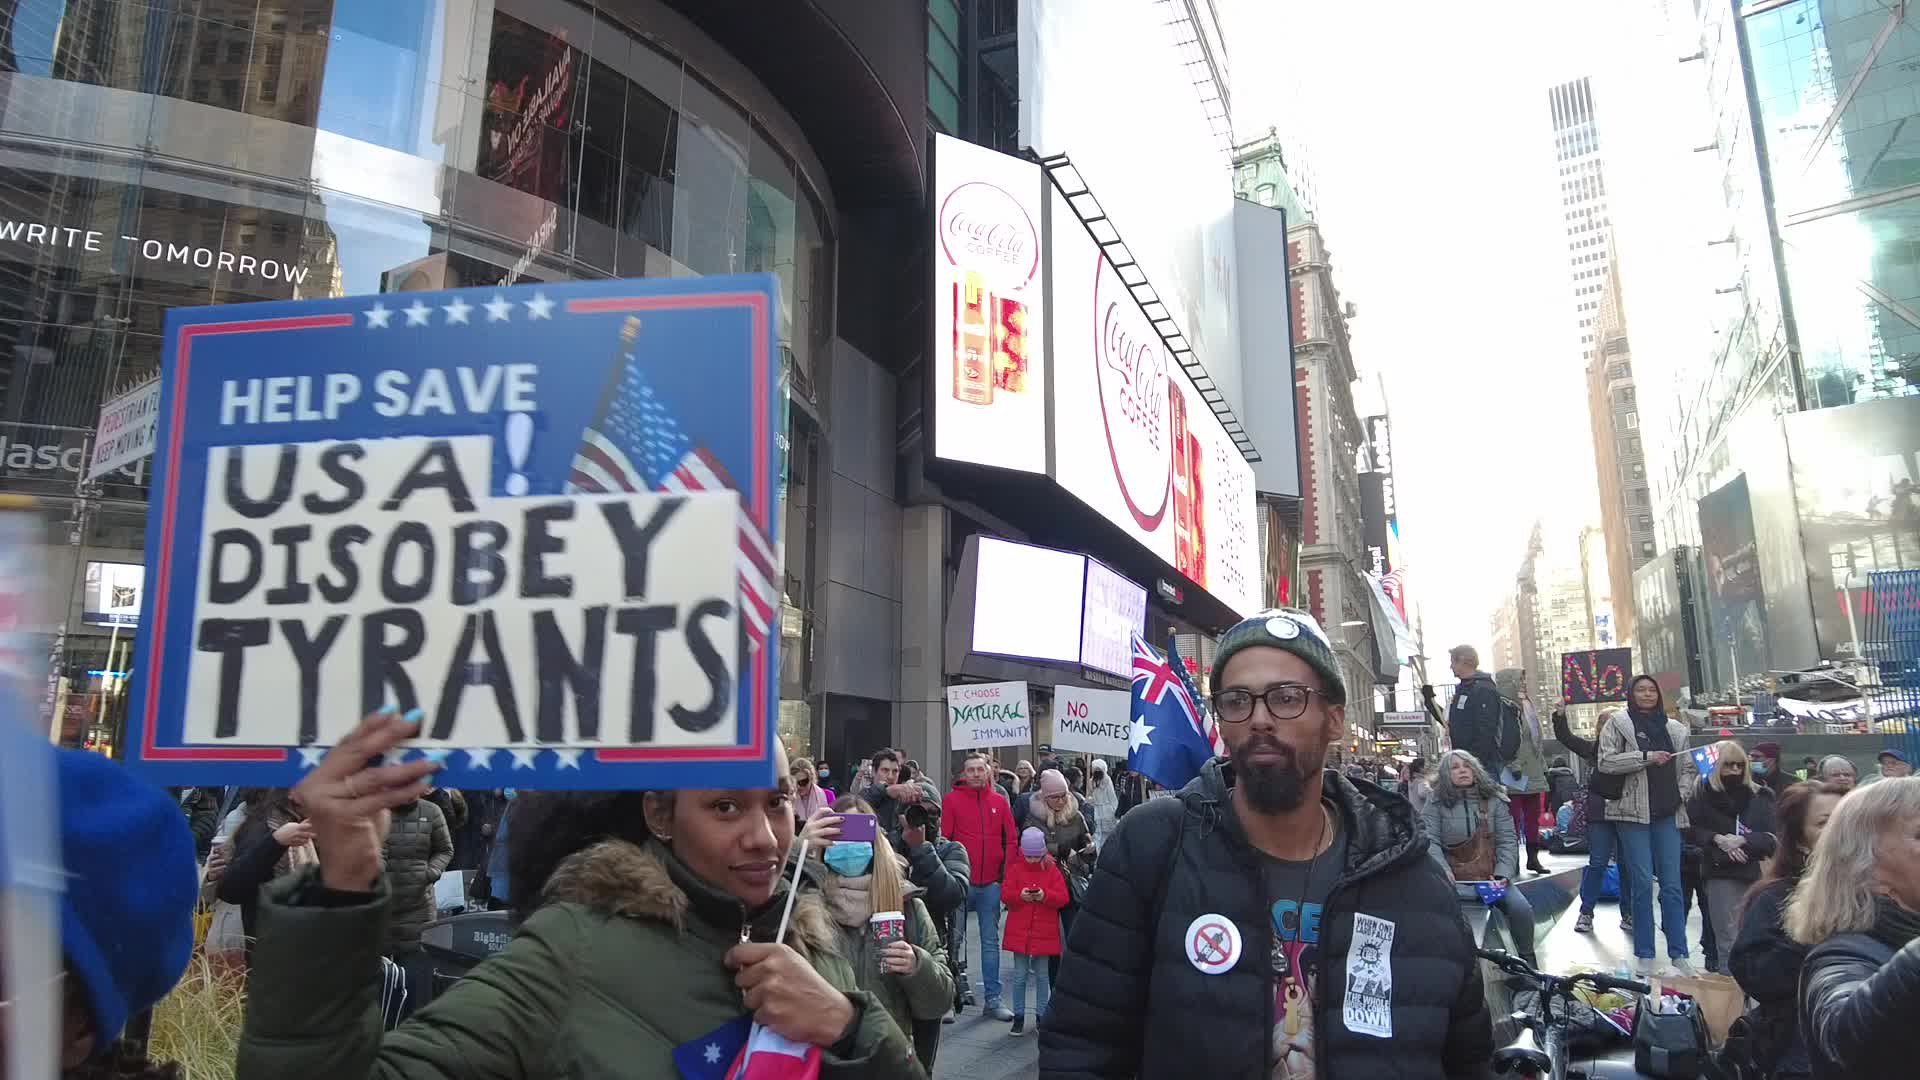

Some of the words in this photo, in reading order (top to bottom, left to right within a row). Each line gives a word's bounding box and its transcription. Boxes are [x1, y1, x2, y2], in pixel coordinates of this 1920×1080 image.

[220, 374, 361, 425] HELP
[374, 364, 538, 416] SAVE
[207, 498, 690, 605] DISOBEY
[198, 599, 731, 745] TYRANTS
[953, 690, 960, 700] I
[964, 688, 1000, 699] CHOOSE
[951, 701, 1025, 727] NATURAL
[1067, 701, 1089, 719] NO
[972, 726, 1031, 741] IMMUNITY
[1060, 719, 1130, 740] MANDATES
[1347, 1008, 1389, 1027] DOWN
